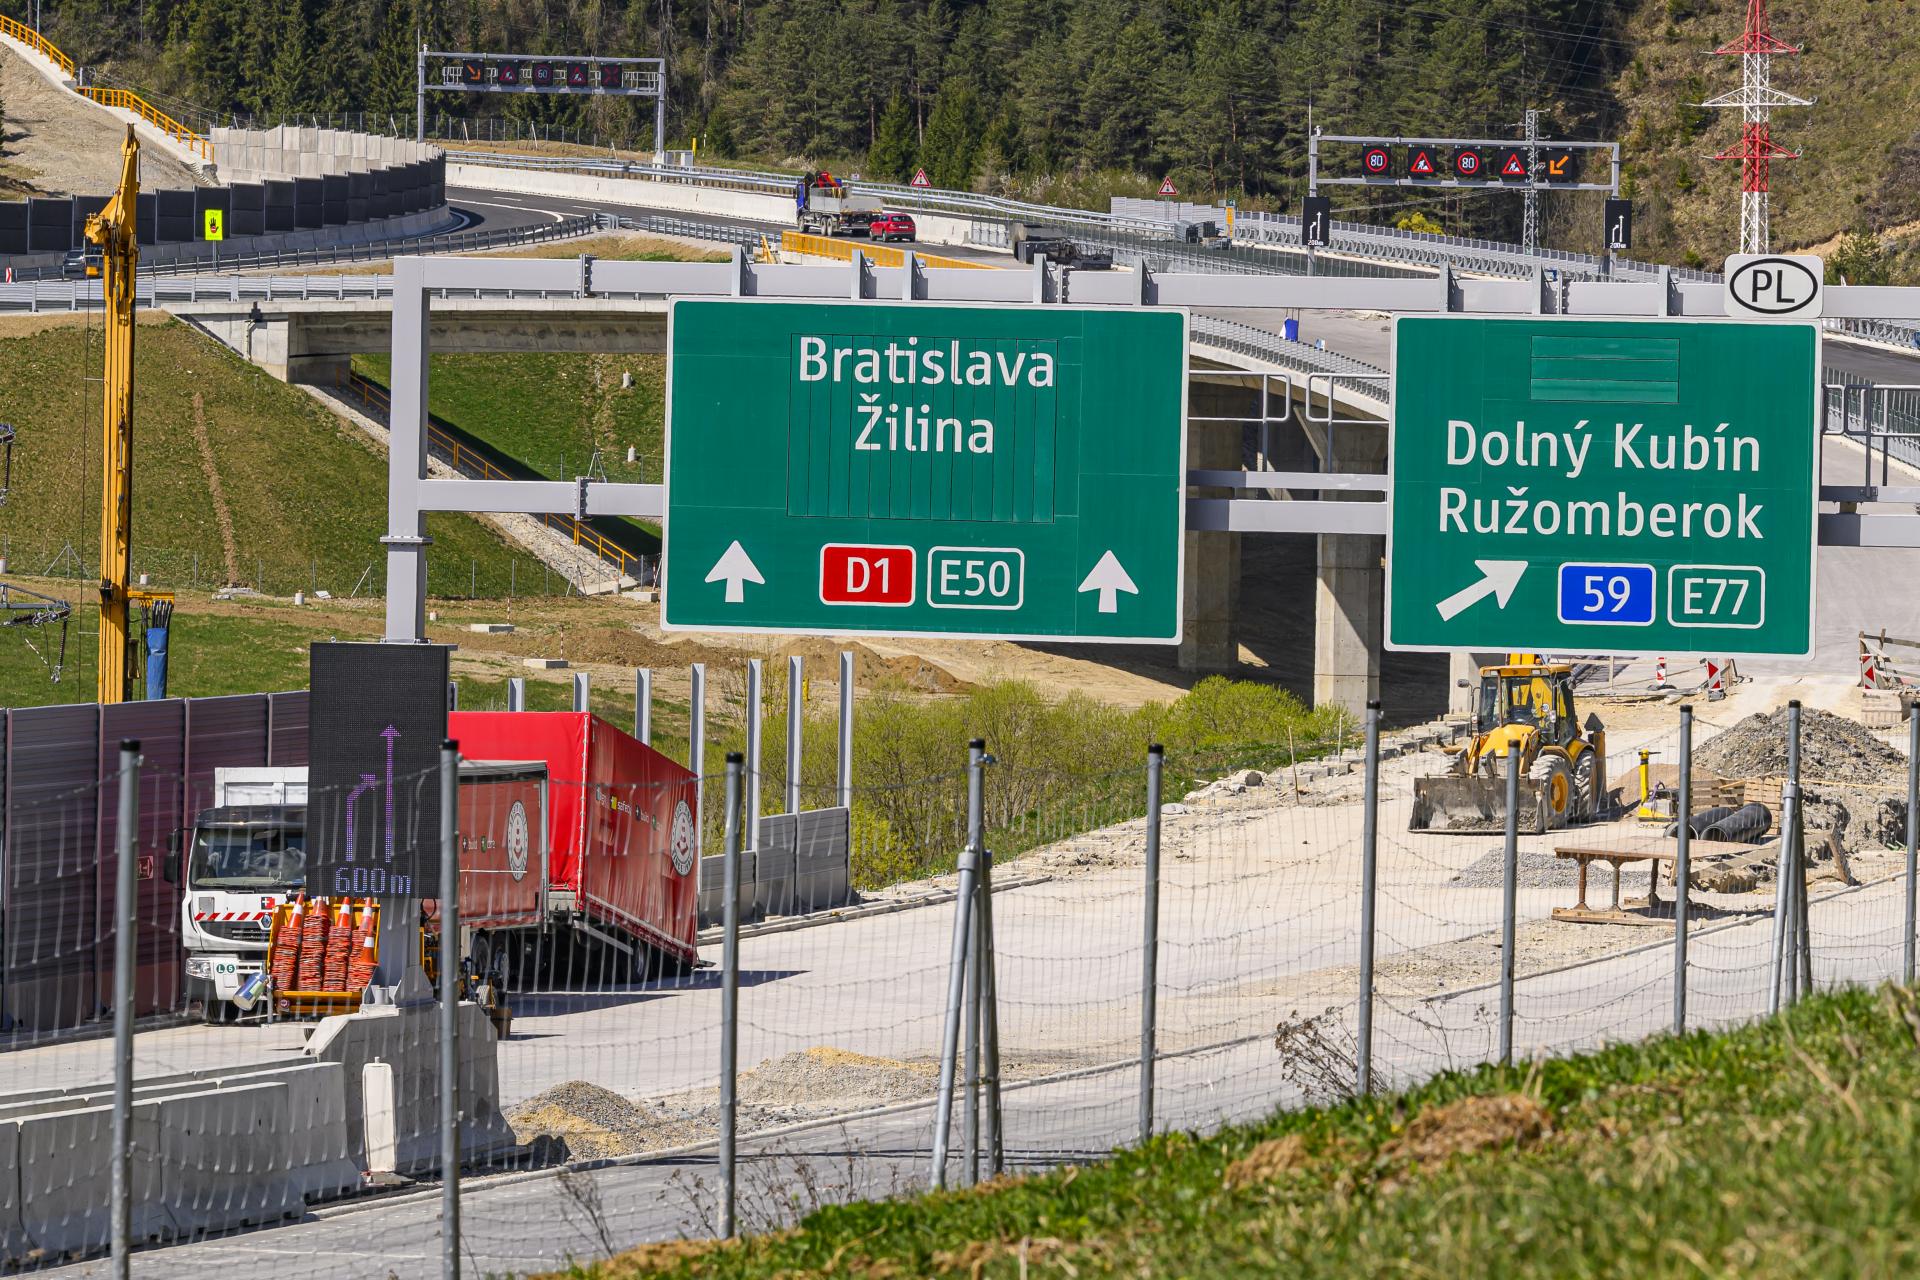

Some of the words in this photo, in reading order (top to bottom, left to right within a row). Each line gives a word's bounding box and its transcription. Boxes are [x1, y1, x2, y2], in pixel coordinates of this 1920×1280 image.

[1370, 155, 1383, 167] 80
[1462, 157, 1475, 169] 80
[1751, 269, 1795, 304] PL
[799, 336, 1055, 388] Bratislava
[854, 392, 994, 454] Žilina
[1446, 419, 1593, 479] Dolný
[1614, 422, 1760, 472] Kubín
[1439, 485, 1764, 539] Ružomberok
[847, 556, 889, 594] D1
[940, 559, 1011, 598] E50
[1583, 575, 1631, 613] 59
[1683, 577, 1750, 616] E77
[335, 867, 411, 894] 600m
